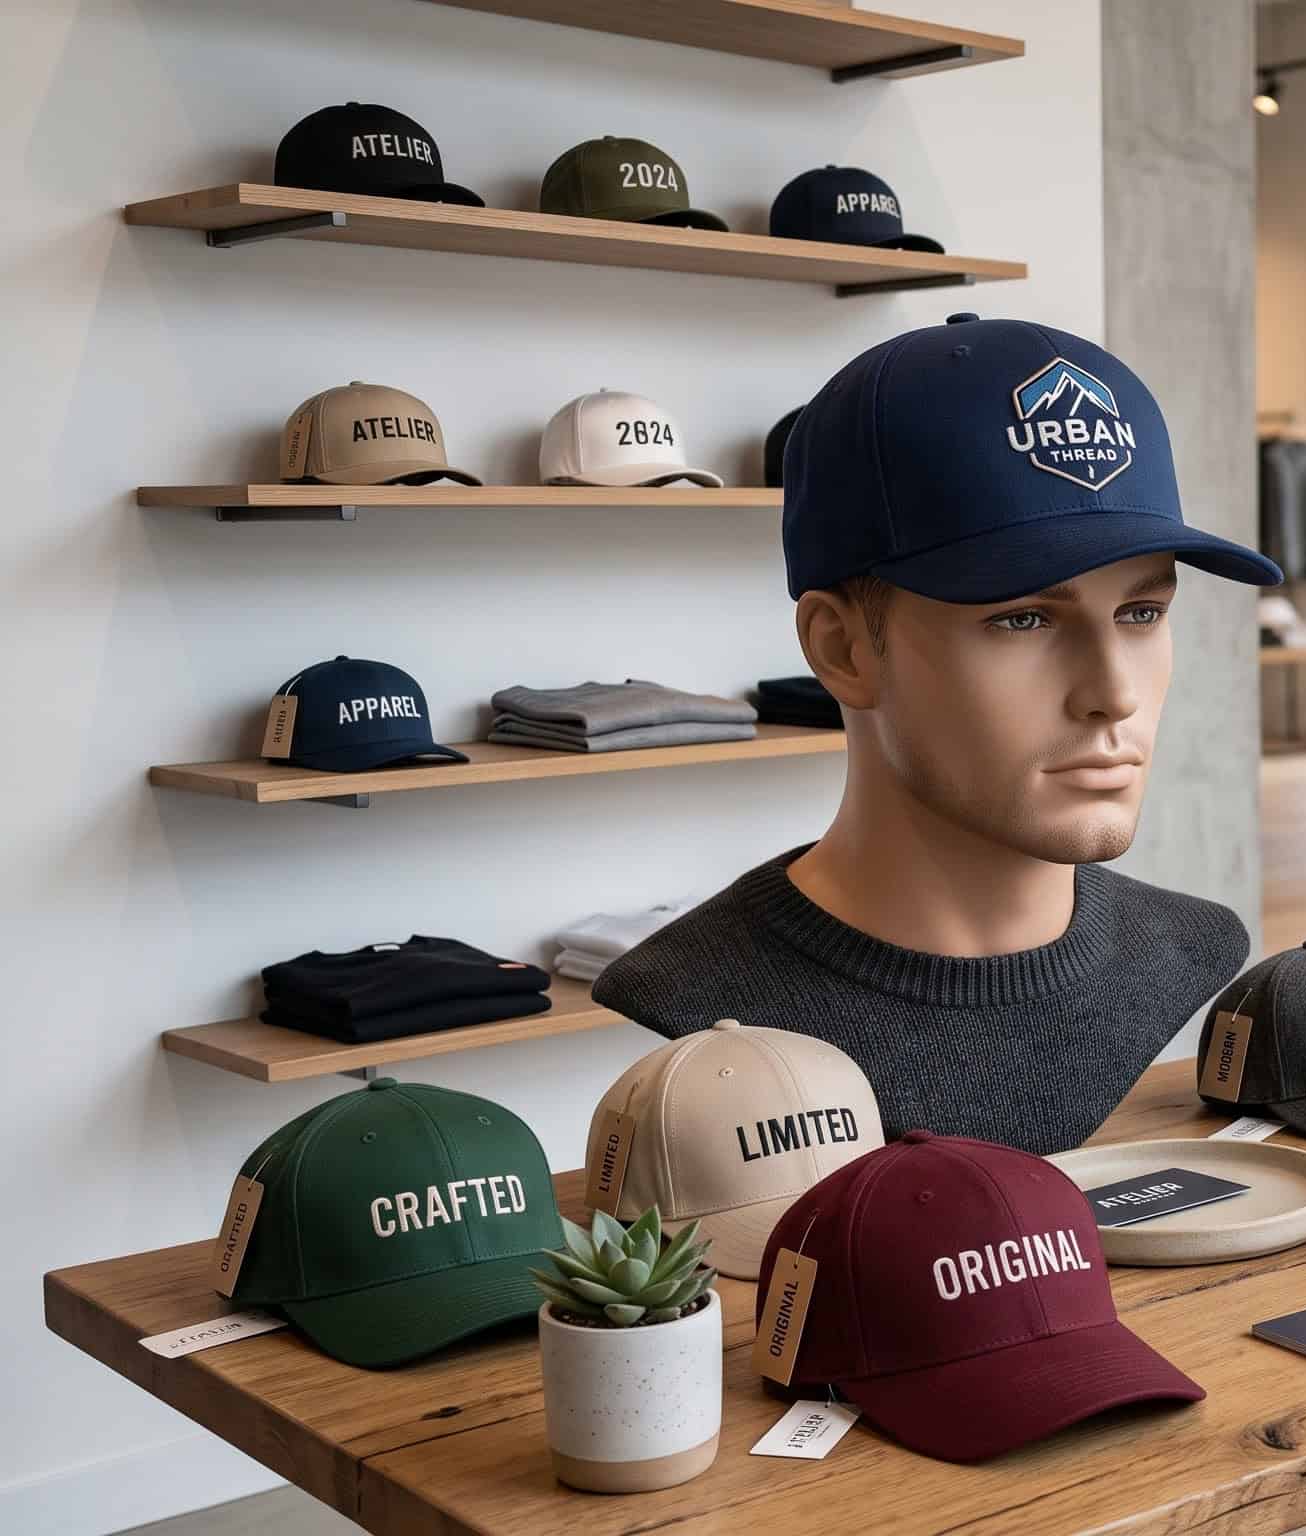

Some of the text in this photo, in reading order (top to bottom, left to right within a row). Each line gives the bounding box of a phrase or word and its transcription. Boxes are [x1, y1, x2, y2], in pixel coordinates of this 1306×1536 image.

[352, 134, 434, 166] ATELIER
[619, 162, 678, 192] 2024
[352, 417, 437, 444] ATELIER
[1006, 418, 1137, 452] URBAN
[1050, 449, 1117, 463] THREAD
[338, 696, 421, 725] APPAREL
[736, 1107, 859, 1163] LIMITED
[599, 1134, 620, 1192] LIMITED
[370, 1174, 527, 1238] CRAFTED
[1096, 1182, 1184, 1208] ATELIER
[932, 1229, 1092, 1301] ORIGINAL
[769, 1280, 799, 1357] ORIGINAL
